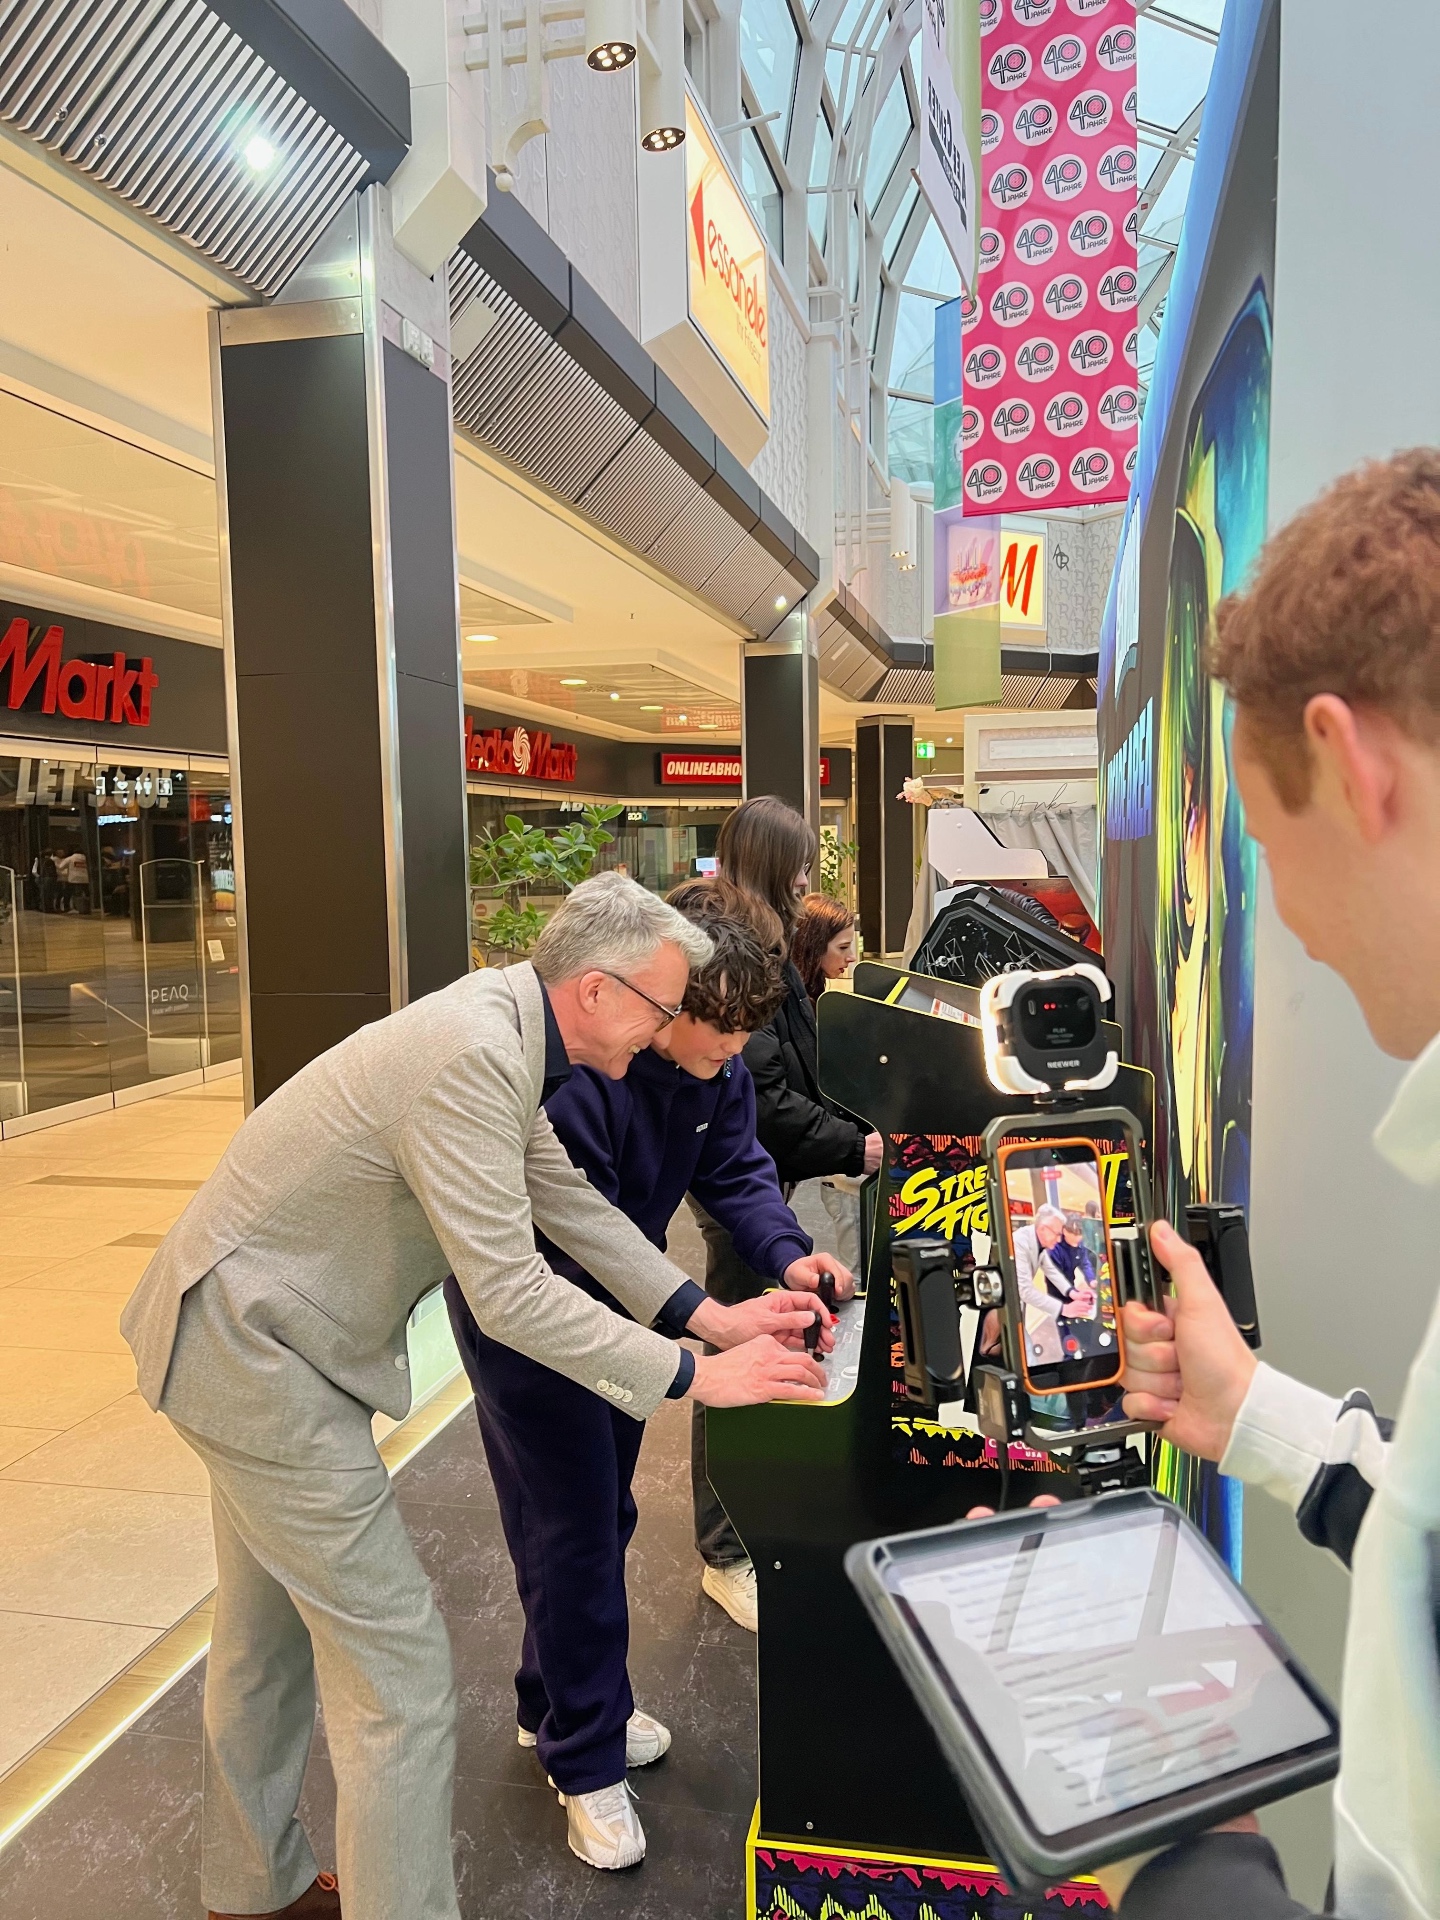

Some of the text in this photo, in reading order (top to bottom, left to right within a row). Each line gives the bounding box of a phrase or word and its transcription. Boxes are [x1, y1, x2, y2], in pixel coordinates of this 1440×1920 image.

[1030, 7, 1052, 19] JAHRE
[1044, 40, 1080, 74] 40
[1098, 30, 1136, 64] 40
[1115, 52, 1136, 63] JAHRE
[990, 50, 1026, 84] 40
[1006, 71, 1027, 83] JAHRE
[1060, 61, 1082, 74] JAHRE
[1016, 104, 1052, 139] 40
[1070, 95, 1107, 130] 40
[1086, 117, 1108, 130] JAHRE
[1032, 126, 1052, 138] JAHRE
[1045, 160, 1082, 194] 40
[1100, 150, 1136, 186] 40
[1116, 173, 1137, 184] JAHRE
[992, 168, 1027, 203] 40
[1006, 191, 1028, 202] JAHRE
[1060, 182, 1082, 194] JAHRE
[1016, 224, 1052, 258] 40
[1070, 216, 1108, 250] 40
[1086, 238, 1108, 250] JAHRE
[1032, 246, 1054, 258] JAHRE
[708, 219, 766, 348] essanelle
[1046, 279, 1082, 314] 40
[1100, 272, 1136, 306] 40
[1116, 294, 1138, 304] JAHRE
[992, 287, 1028, 321] 40
[1008, 308, 1030, 320] JAHRE
[1062, 300, 1083, 312] JAHRE
[966, 350, 1000, 382] 40
[1018, 342, 1054, 376] 40
[1070, 336, 1108, 369] 40
[1087, 356, 1108, 368] JAHRE
[980, 370, 1002, 382] JAHRE
[1034, 364, 1054, 376] JAHRE
[994, 404, 1029, 436] 40
[1046, 397, 1082, 430] 40
[1100, 391, 1137, 424] 40
[1116, 414, 1138, 424] JAHRE
[1010, 425, 1030, 436] JAHRE
[1062, 418, 1084, 430] JAHRE
[966, 464, 1002, 497] 40
[1019, 458, 1054, 492] 40
[1034, 480, 1055, 490] JAHRE
[1072, 452, 1108, 486] 40
[1088, 474, 1109, 486] JAHRE
[982, 486, 1002, 496] JAHRE
[0, 618, 160, 726] Markt
[530, 731, 578, 782] Markt
[666, 760, 742, 776] ONLINEABHO
[1126, 697, 1153, 840] AREA
[151, 984, 189, 1004] PEAQ
[1046, 1060, 1080, 1069] NEEWER
[890, 1164, 989, 1237] STRE
